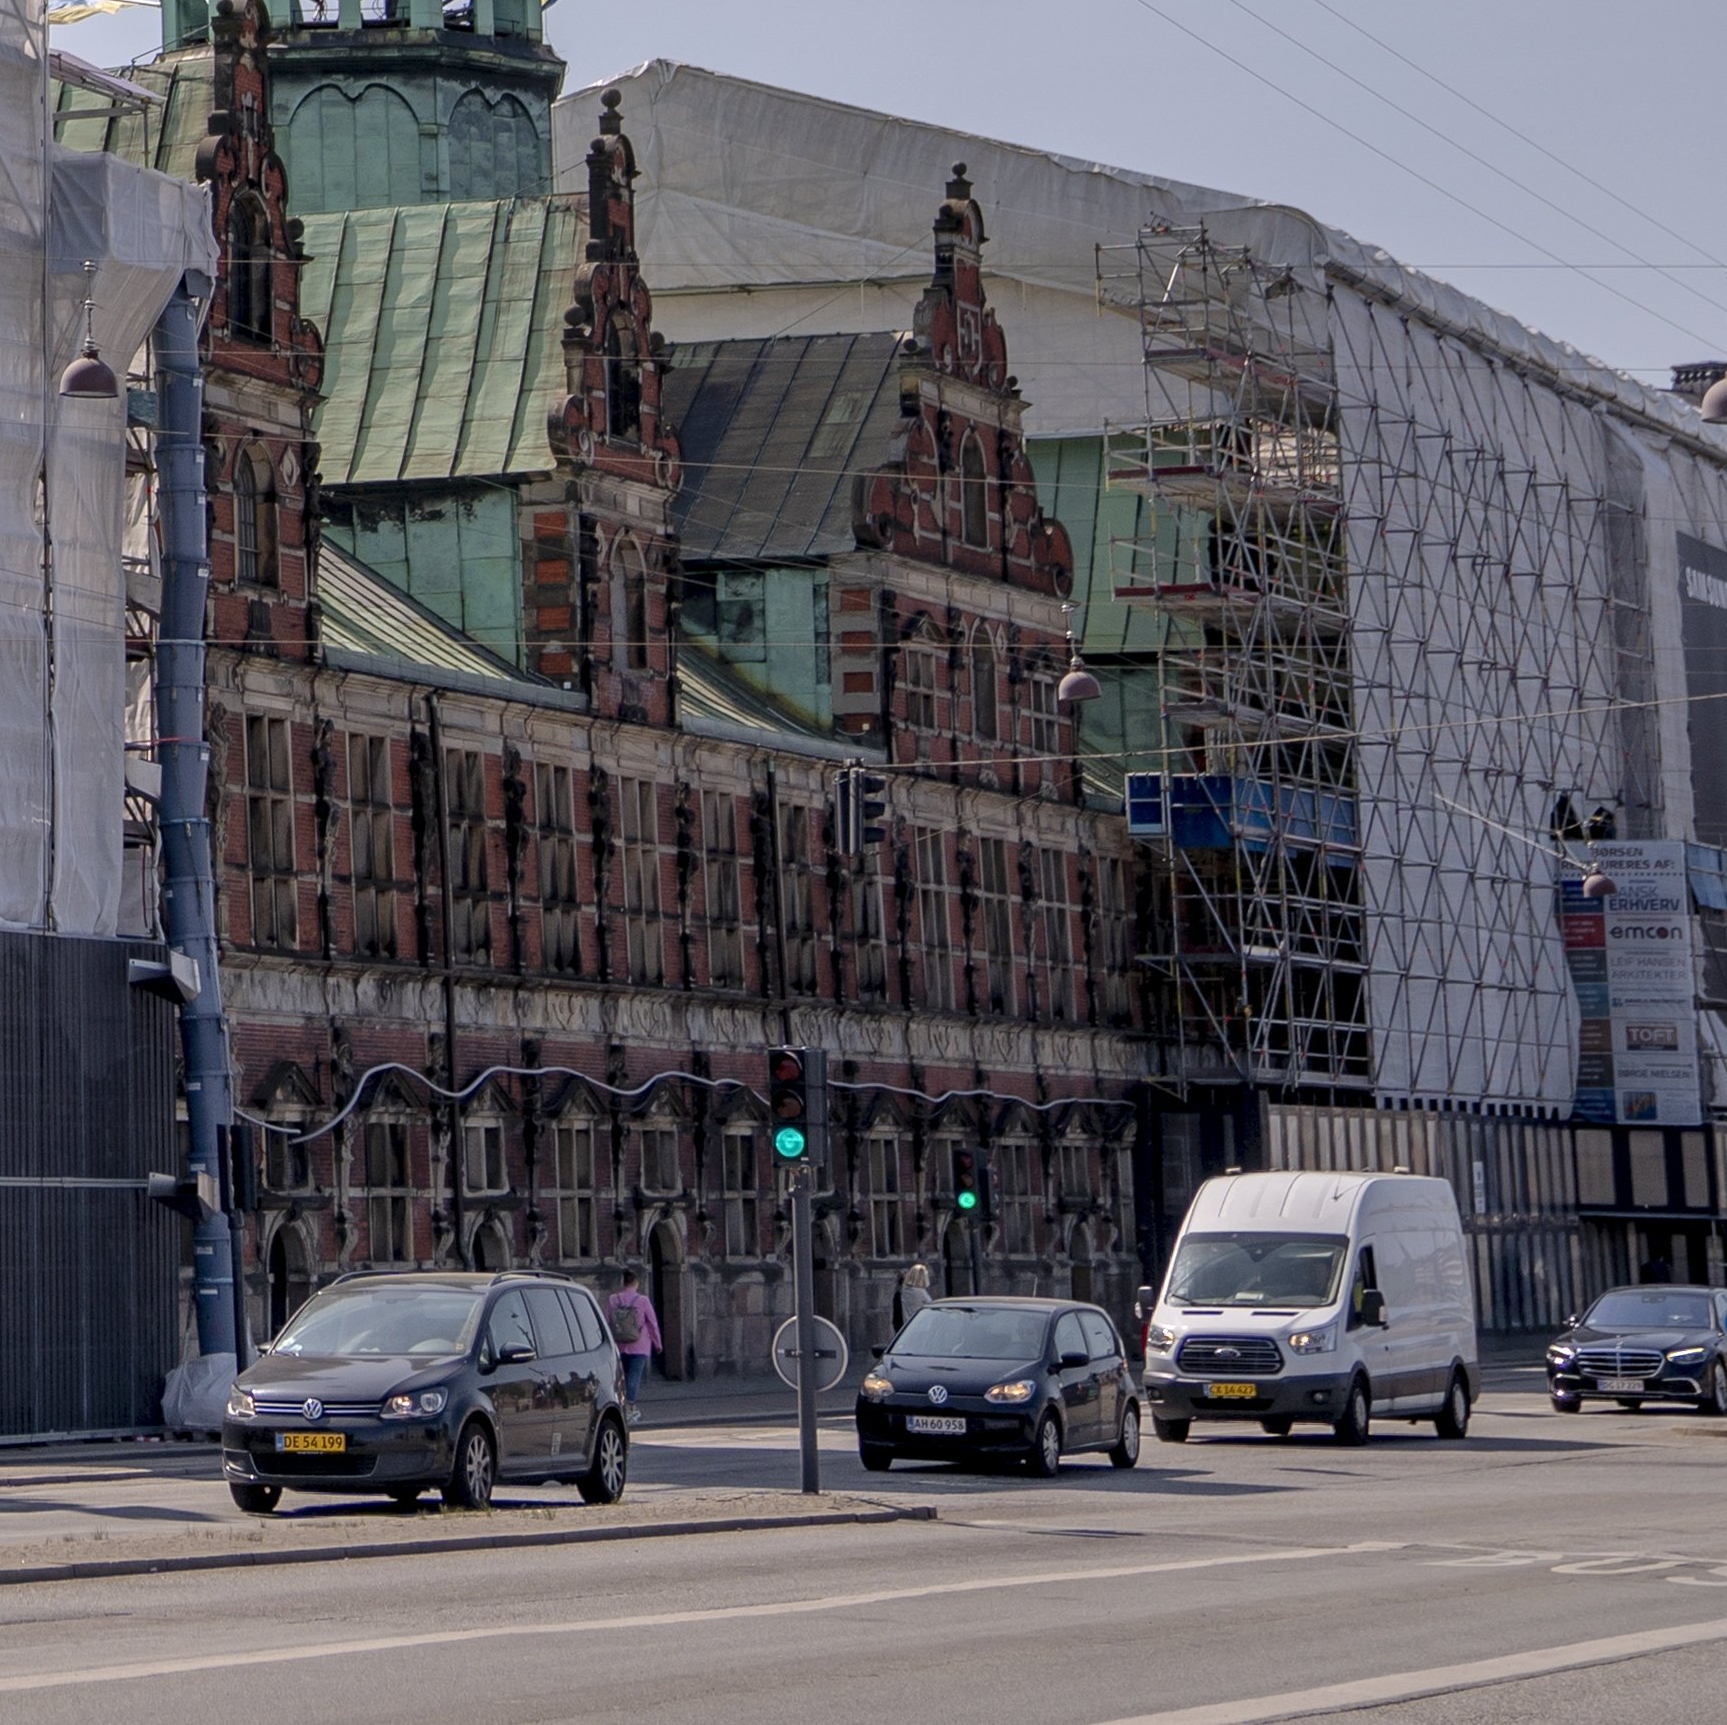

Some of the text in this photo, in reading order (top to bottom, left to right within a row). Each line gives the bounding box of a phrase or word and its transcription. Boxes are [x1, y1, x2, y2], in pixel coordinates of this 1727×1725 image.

[1610, 886, 1658, 898] ANSK
[1609, 898, 1680, 911] ERHVERV
[1609, 927, 1683, 939] emcon
[1628, 1028, 1675, 1042] TOFT
[914, 1418, 964, 1430] AH 60 958
[284, 1436, 343, 1448] DE 54 199
